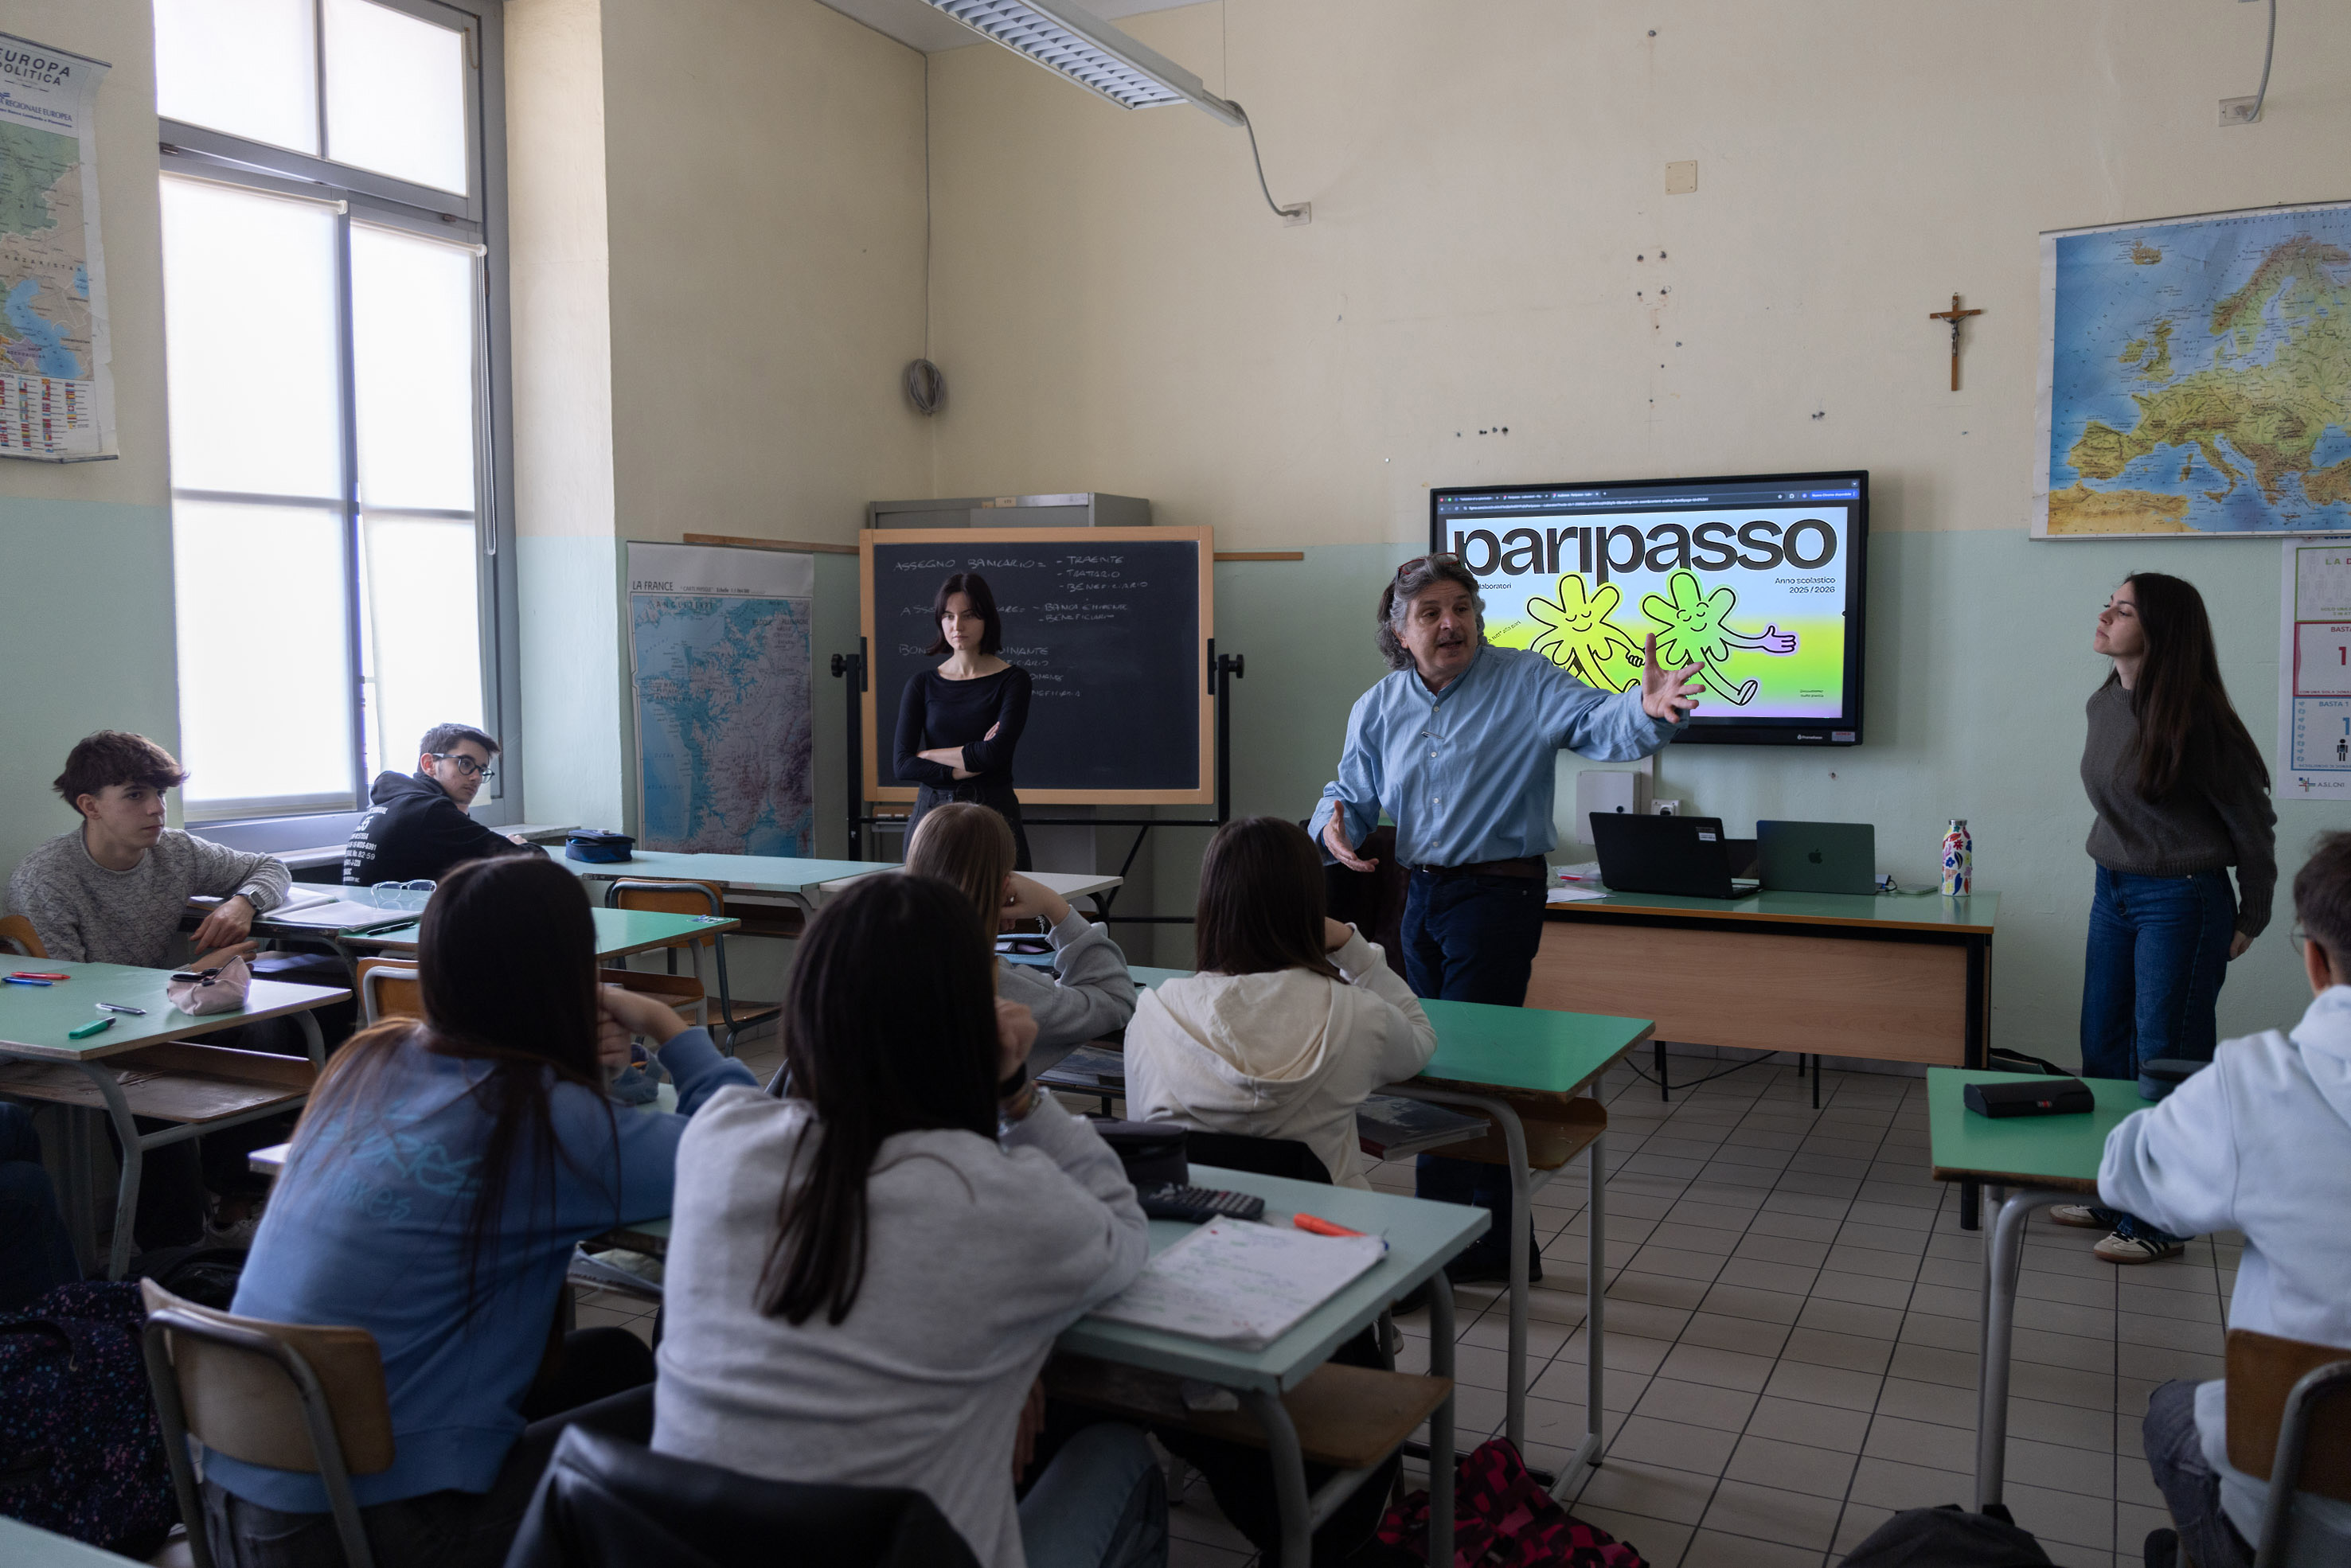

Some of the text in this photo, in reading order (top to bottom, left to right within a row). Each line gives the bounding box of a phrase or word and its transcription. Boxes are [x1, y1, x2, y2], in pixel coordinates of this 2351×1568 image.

[6, 99, 41, 114] REGIONALE
[43, 110, 72, 122] EUROPEA
[1066, 556, 1125, 565] TRAENTE
[1454, 518, 1837, 587] paripasso
[893, 559, 956, 572] ASSEGNO
[967, 558, 1036, 569] BANCARIO
[633, 580, 674, 591] LA FRANCE
[2338, 646, 2347, 666] 1
[2342, 717, 2350, 736] 1
